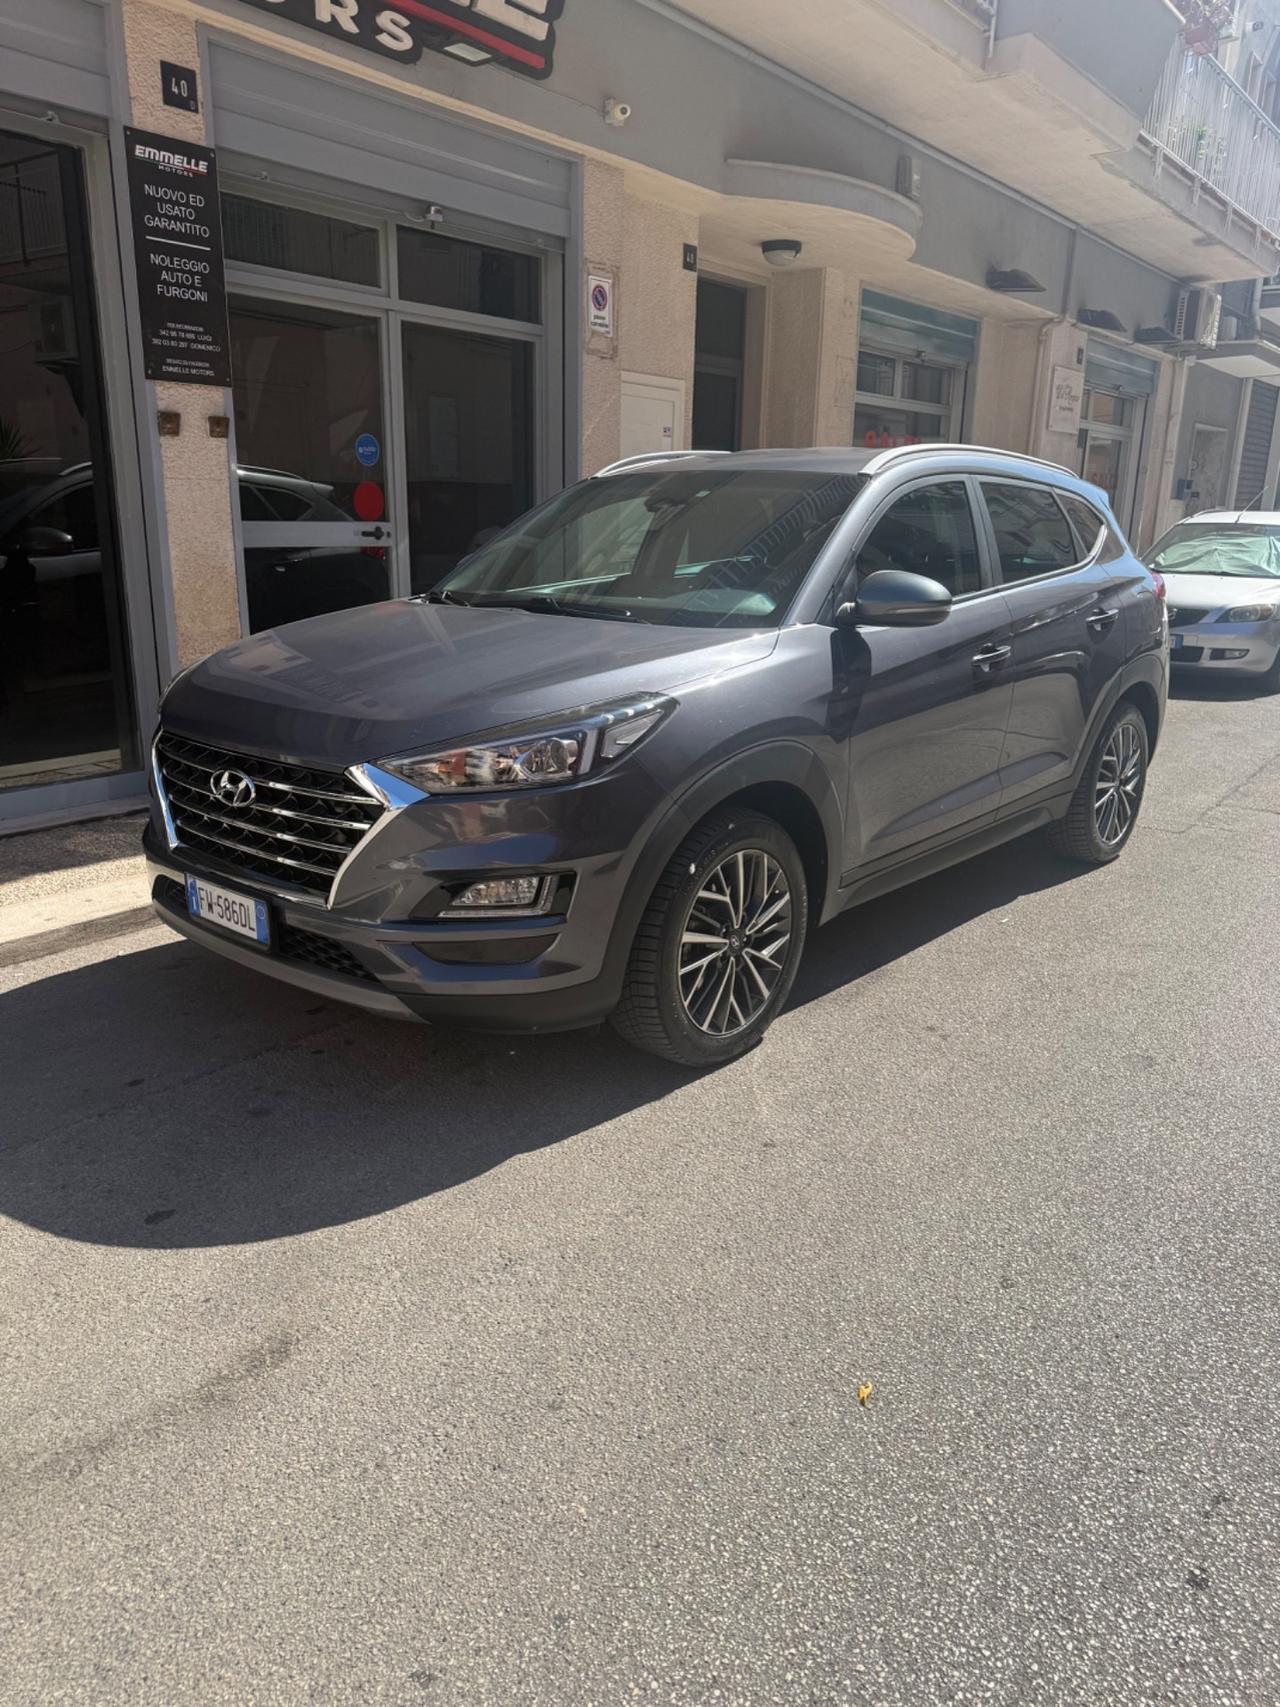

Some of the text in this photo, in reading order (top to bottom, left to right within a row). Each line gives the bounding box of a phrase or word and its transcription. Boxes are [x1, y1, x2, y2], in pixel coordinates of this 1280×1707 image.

[171, 77, 188, 97] 40
[134, 144, 208, 173] EMMELLE
[158, 165, 194, 178] MOTORS
[144, 183, 205, 207] NUOVO ED
[157, 201, 196, 220] USATO
[144, 215, 210, 238] GARANTITO
[150, 253, 210, 274] NOLEGGIO
[160, 270, 203, 287] AUTO E
[157, 284, 208, 302] FURGONI
[190, 342, 221, 352] DOMENICO
